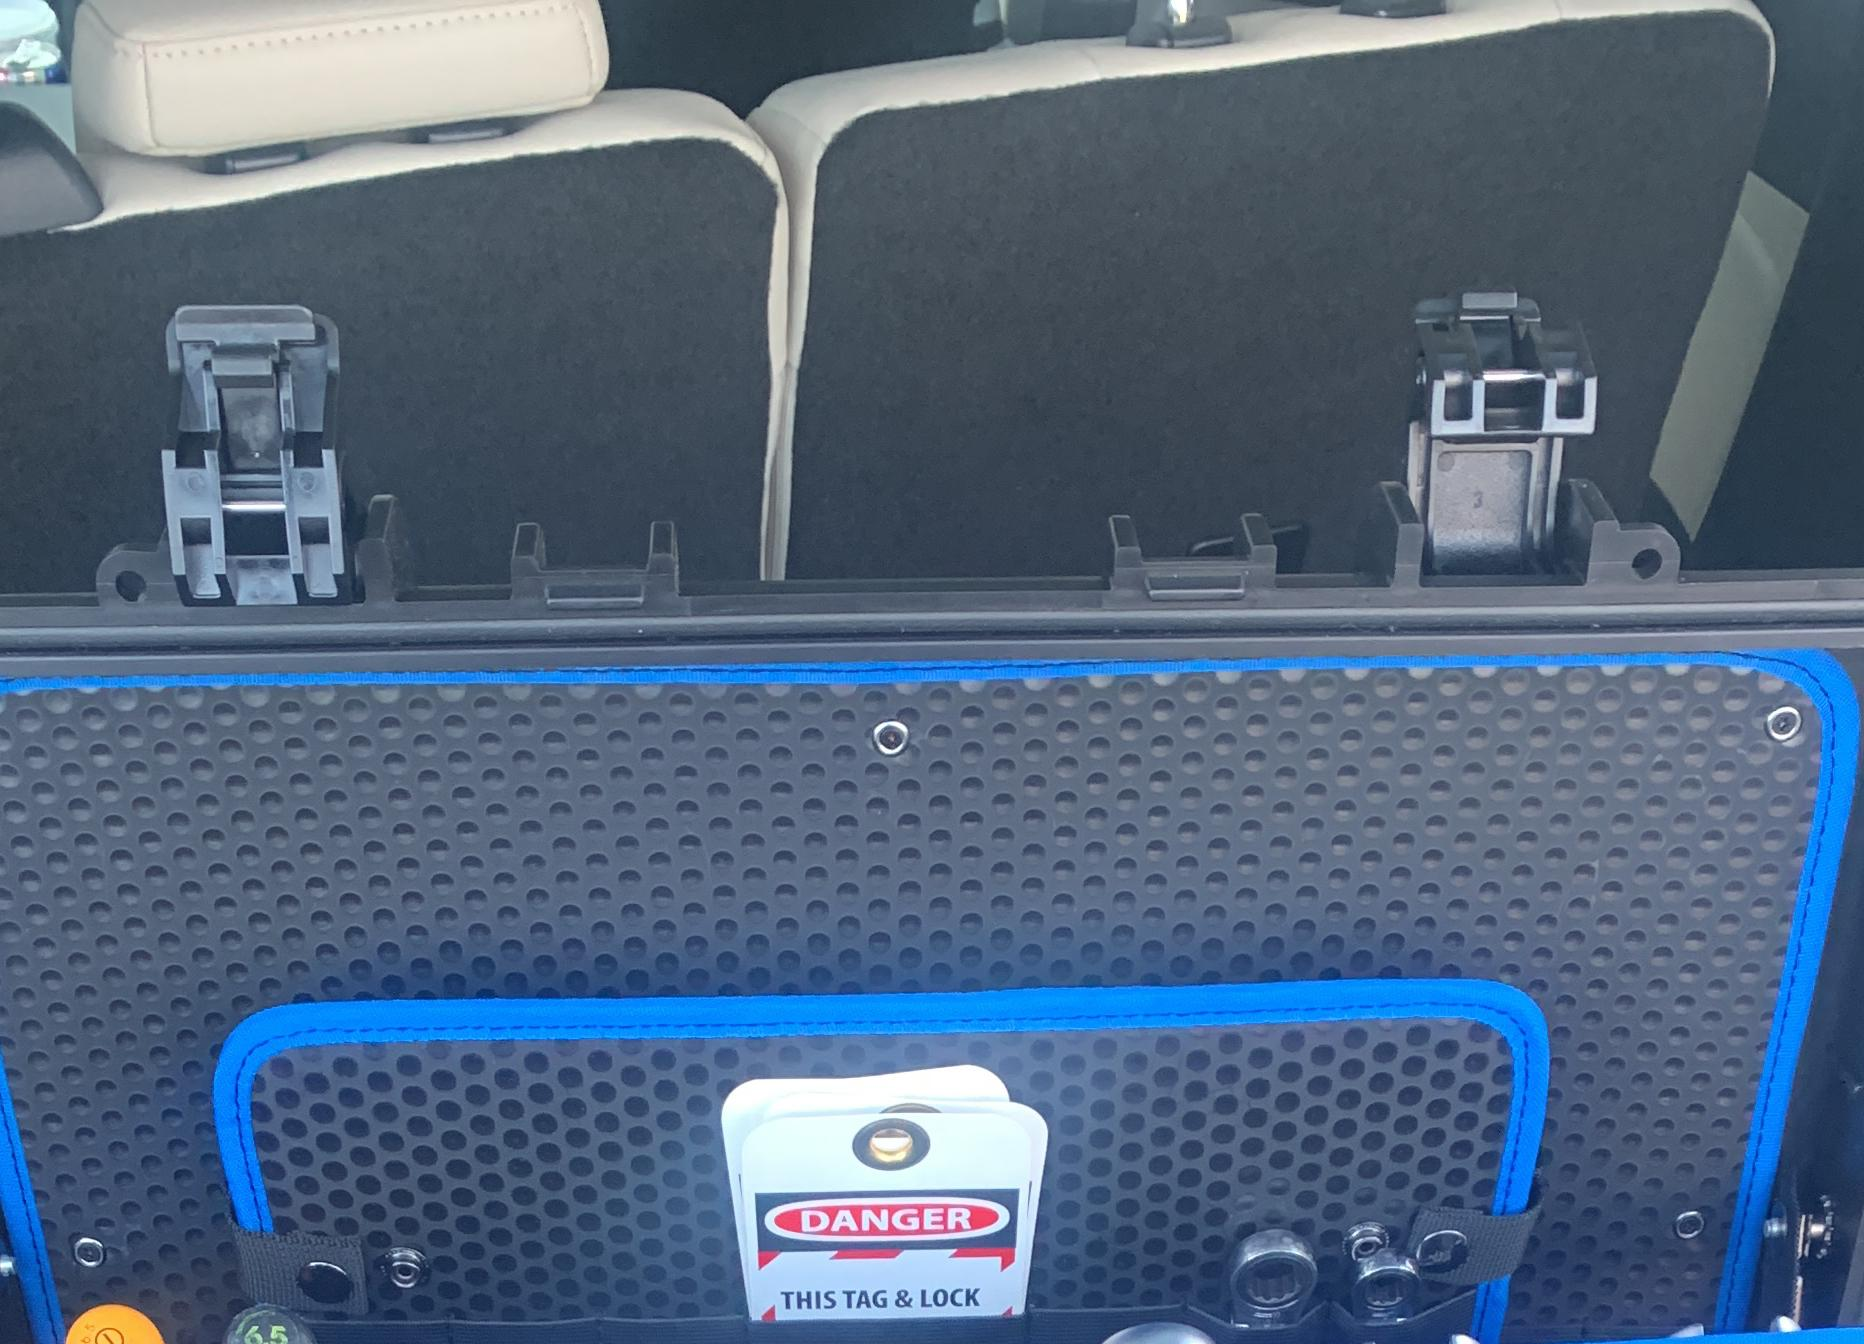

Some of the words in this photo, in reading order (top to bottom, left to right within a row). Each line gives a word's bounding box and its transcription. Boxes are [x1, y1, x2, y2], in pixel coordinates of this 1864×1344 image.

[801, 1207, 972, 1233] DANGER
[781, 1290, 837, 1310] THIS
[843, 1289, 888, 1309] TAG
[894, 1289, 914, 1309] &
[920, 1288, 982, 1308] LOCK
